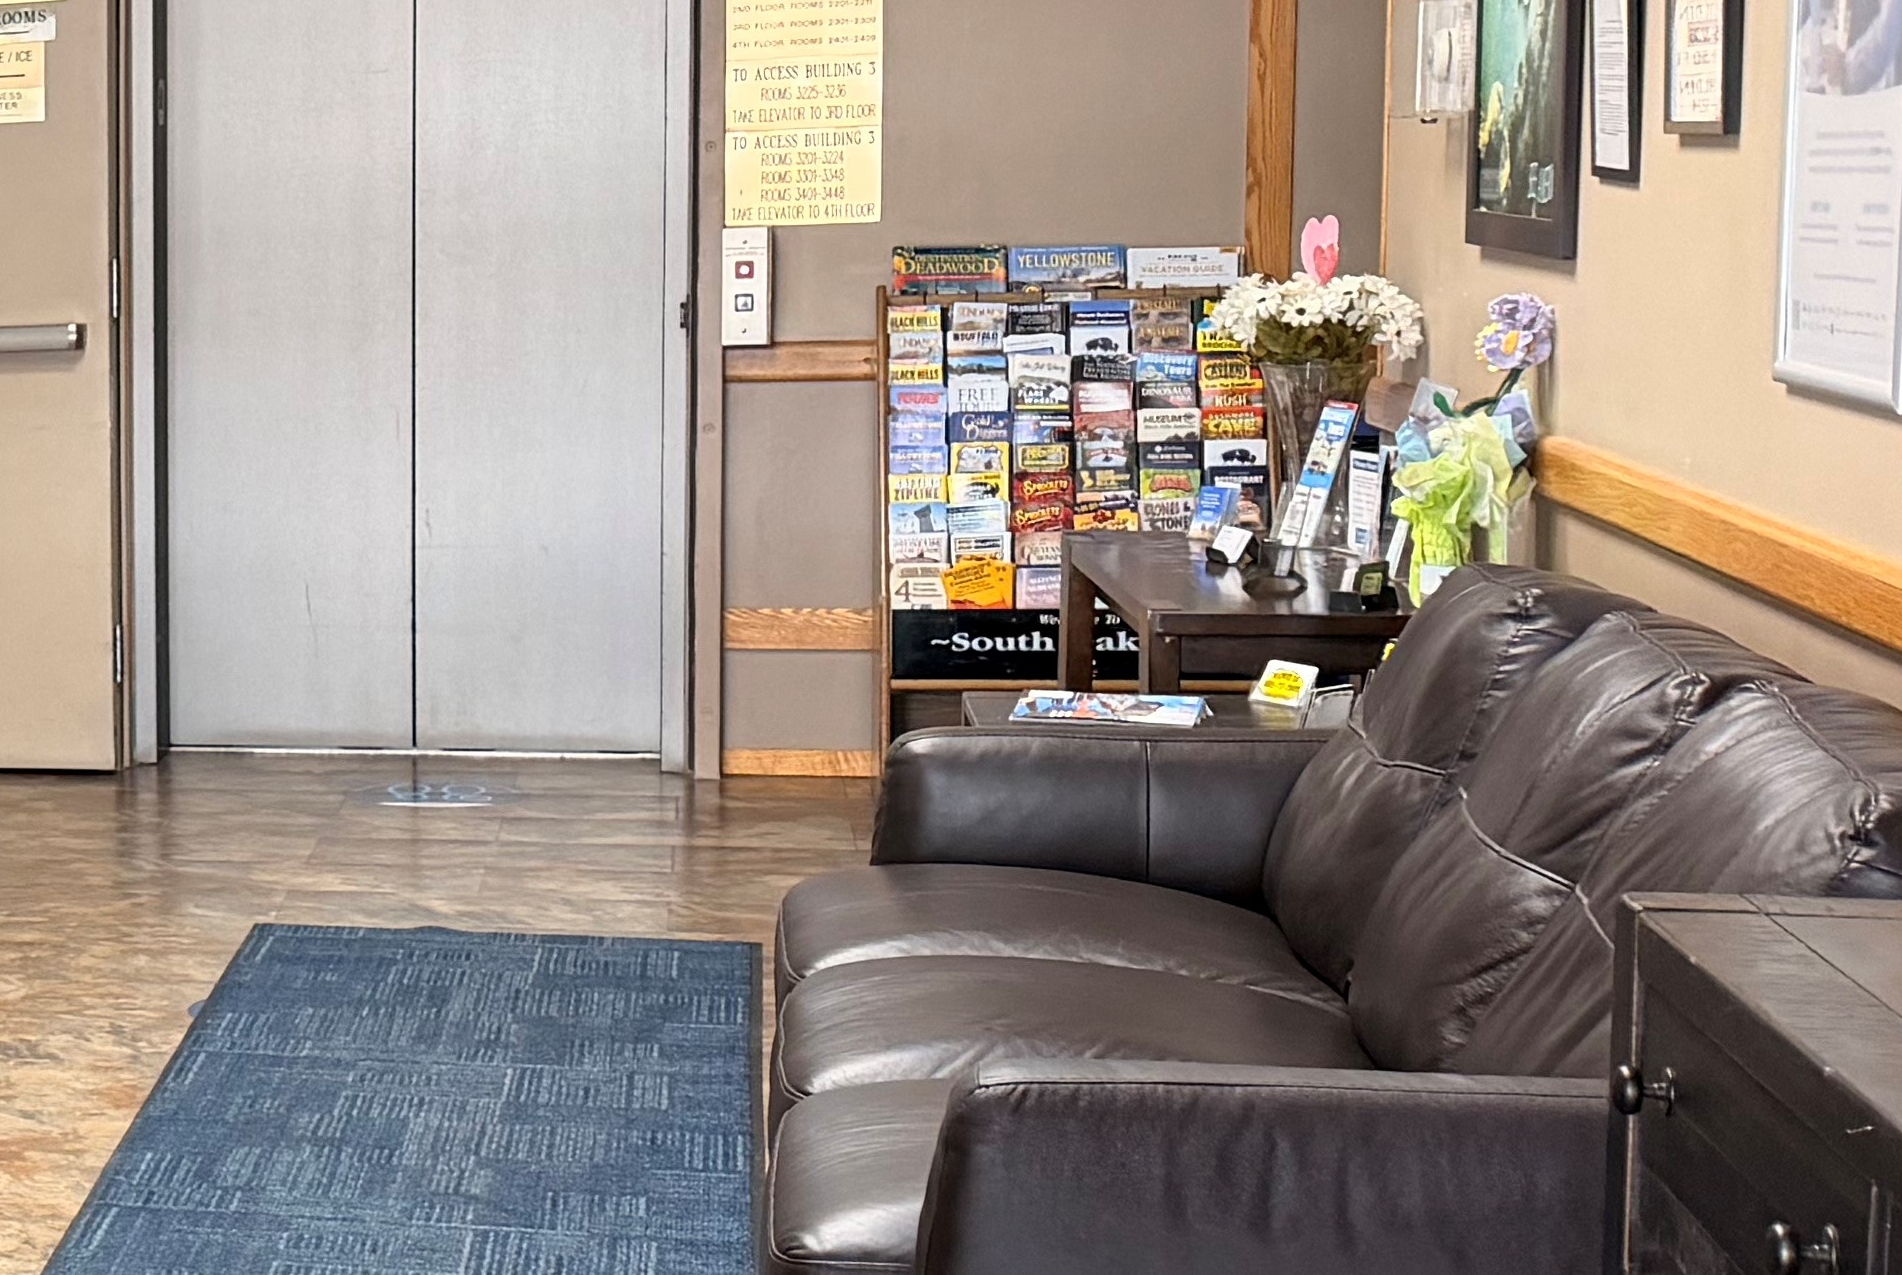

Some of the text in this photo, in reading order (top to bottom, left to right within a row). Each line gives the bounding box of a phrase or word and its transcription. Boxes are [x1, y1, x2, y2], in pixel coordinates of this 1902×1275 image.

[15, 50, 32, 62] ICE
[733, 61, 876, 82] TO ACCESS BUILDING 3
[760, 87, 792, 101] ROOMS
[733, 109, 754, 123] TAKE
[758, 106, 806, 123] ELEVATOR
[810, 106, 822, 120] TO
[846, 104, 876, 119] FLOOR
[733, 130, 875, 150] TO ACCESS BUILDING 3
[761, 153, 793, 166] ROOMS
[761, 170, 793, 184] ROOMS
[760, 188, 792, 202] ROOMS
[732, 203, 875, 221] TAKE ELEVATOR TO 4TH FLOOR
[903, 258, 999, 274] DEADWOOD
[1017, 252, 1115, 269] YELLOWSTONE
[891, 316, 914, 328] BLACK
[891, 369, 915, 381] BLACK
[958, 388, 998, 402] FREE
